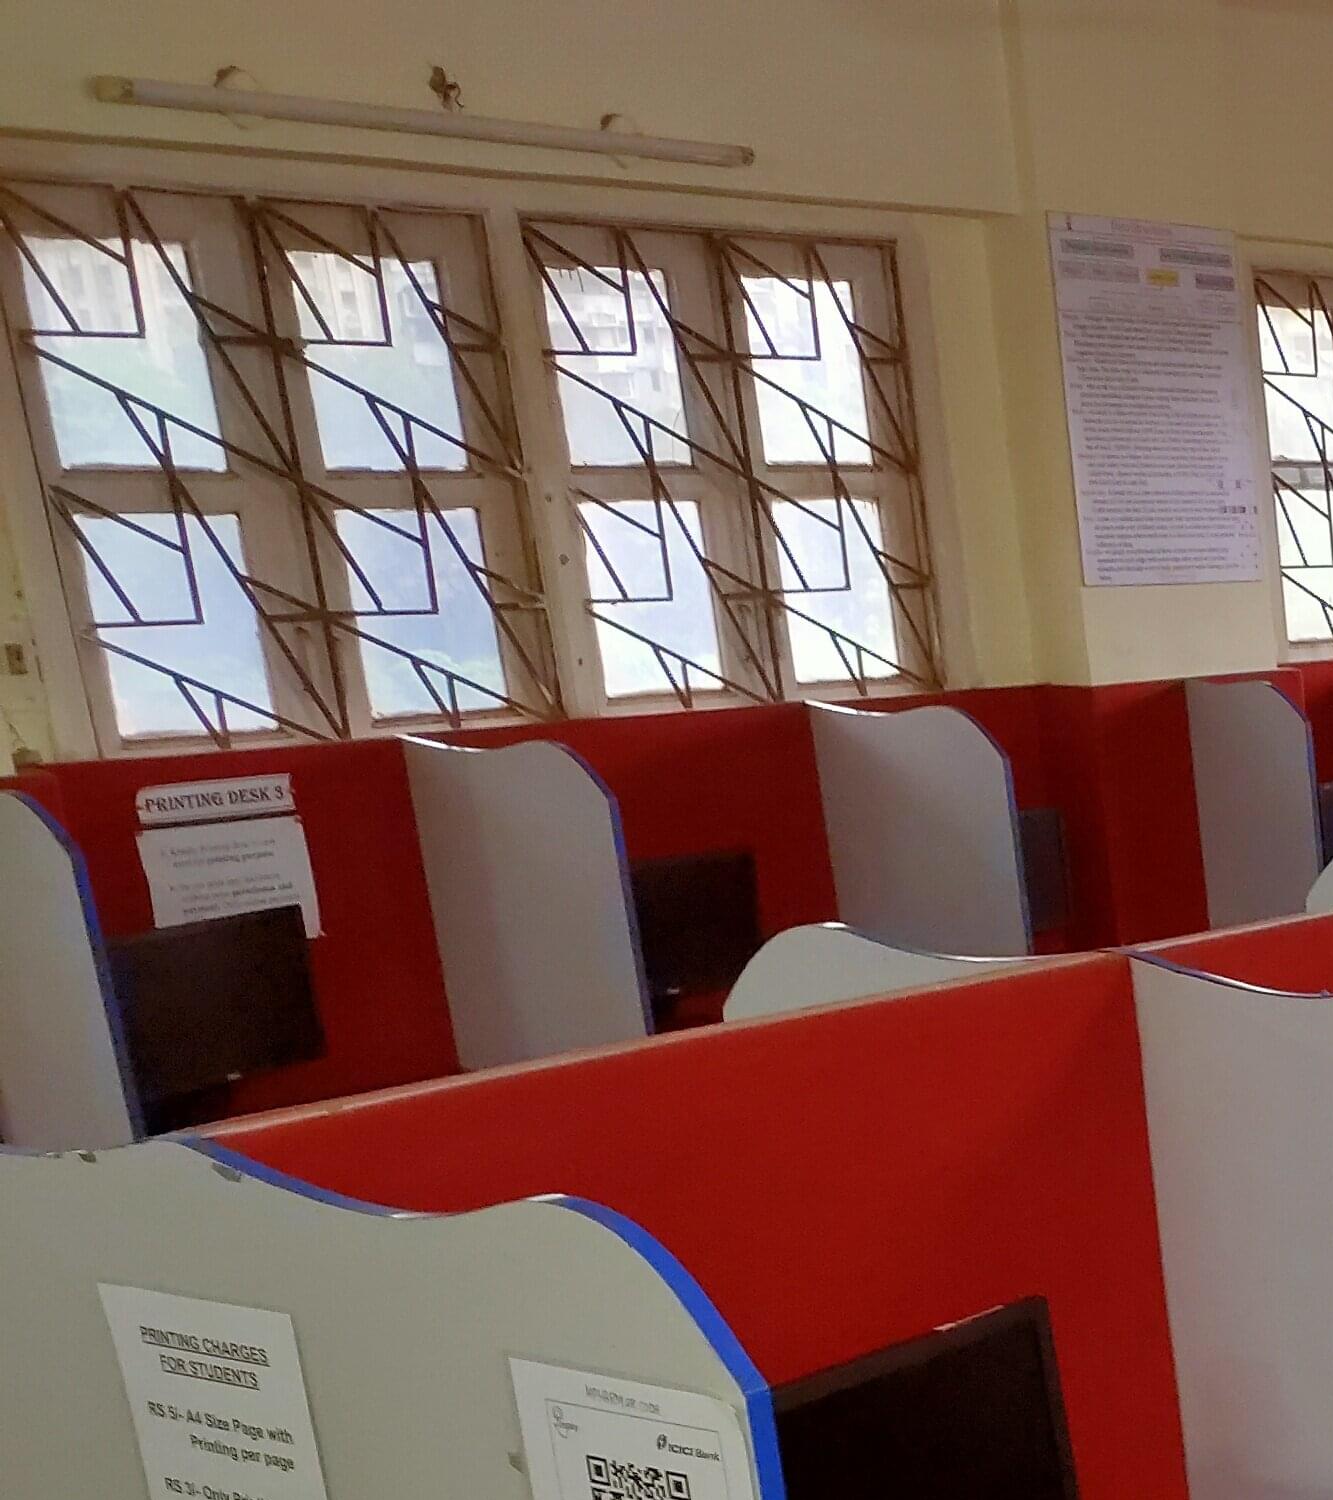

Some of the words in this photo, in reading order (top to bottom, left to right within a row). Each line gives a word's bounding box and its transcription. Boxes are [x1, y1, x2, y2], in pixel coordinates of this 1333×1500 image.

[144, 792, 224, 813] PRINTING
[228, 787, 272, 805] DESK
[274, 785, 284, 798] 3
[139, 1325, 199, 1350] PRINTING
[202, 1338, 268, 1363] CHARGES
[159, 1354, 186, 1373] FOR
[189, 1360, 259, 1386] STUDENTS
[148, 1401, 165, 1418] RS
[186, 1409, 202, 1425] A4
[205, 1413, 230, 1431] Size
[232, 1418, 264, 1441] Page
[266, 1426, 294, 1444] with
[189, 1434, 238, 1461] Printing
[241, 1448, 260, 1462] per
[264, 1453, 294, 1471] page
[695, 1448, 720, 1461] Bank
[164, 1477, 182, 1494] RS
